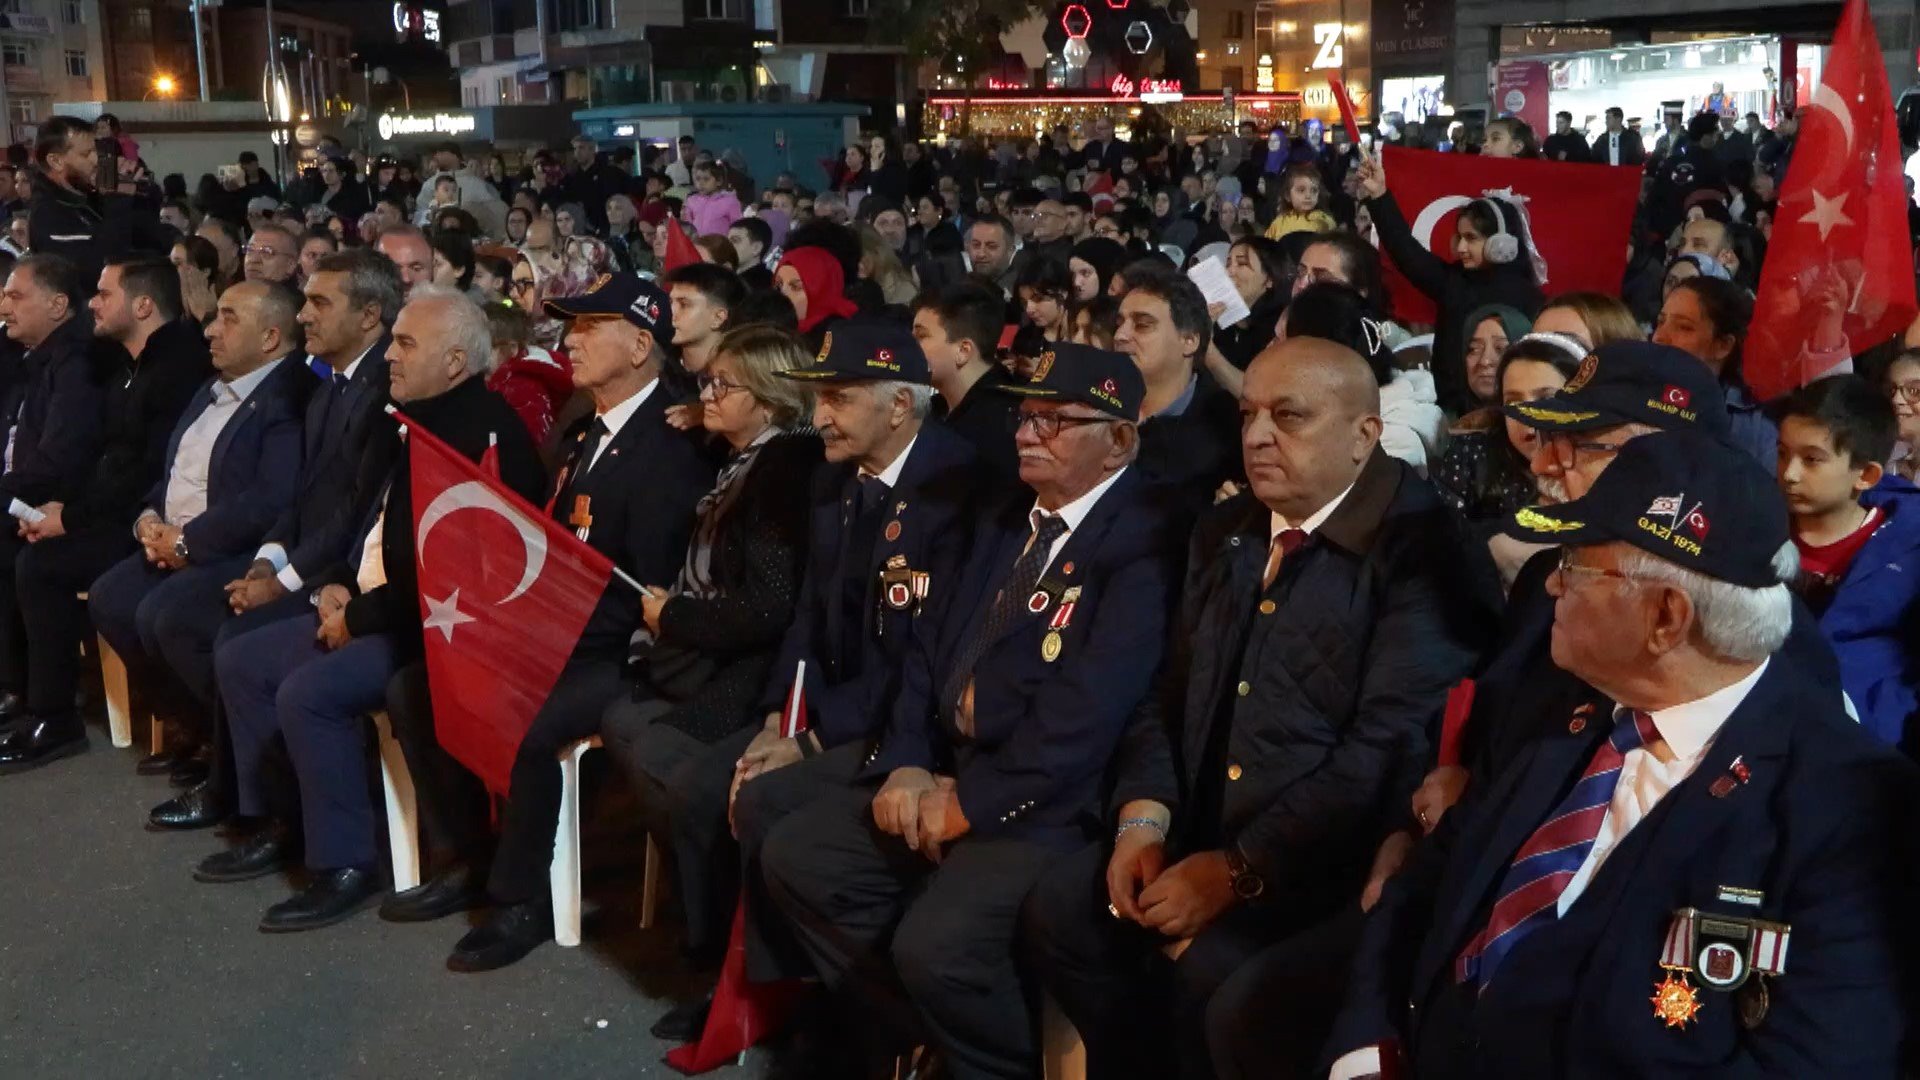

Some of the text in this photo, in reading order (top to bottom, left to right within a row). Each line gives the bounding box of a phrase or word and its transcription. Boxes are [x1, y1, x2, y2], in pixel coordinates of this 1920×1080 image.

[1312, 22, 1343, 69] Z
[1376, 36, 1447, 53] MEN CLASSIC
[1112, 73, 1134, 99] big
[1673, 535, 1702, 556] 1974
